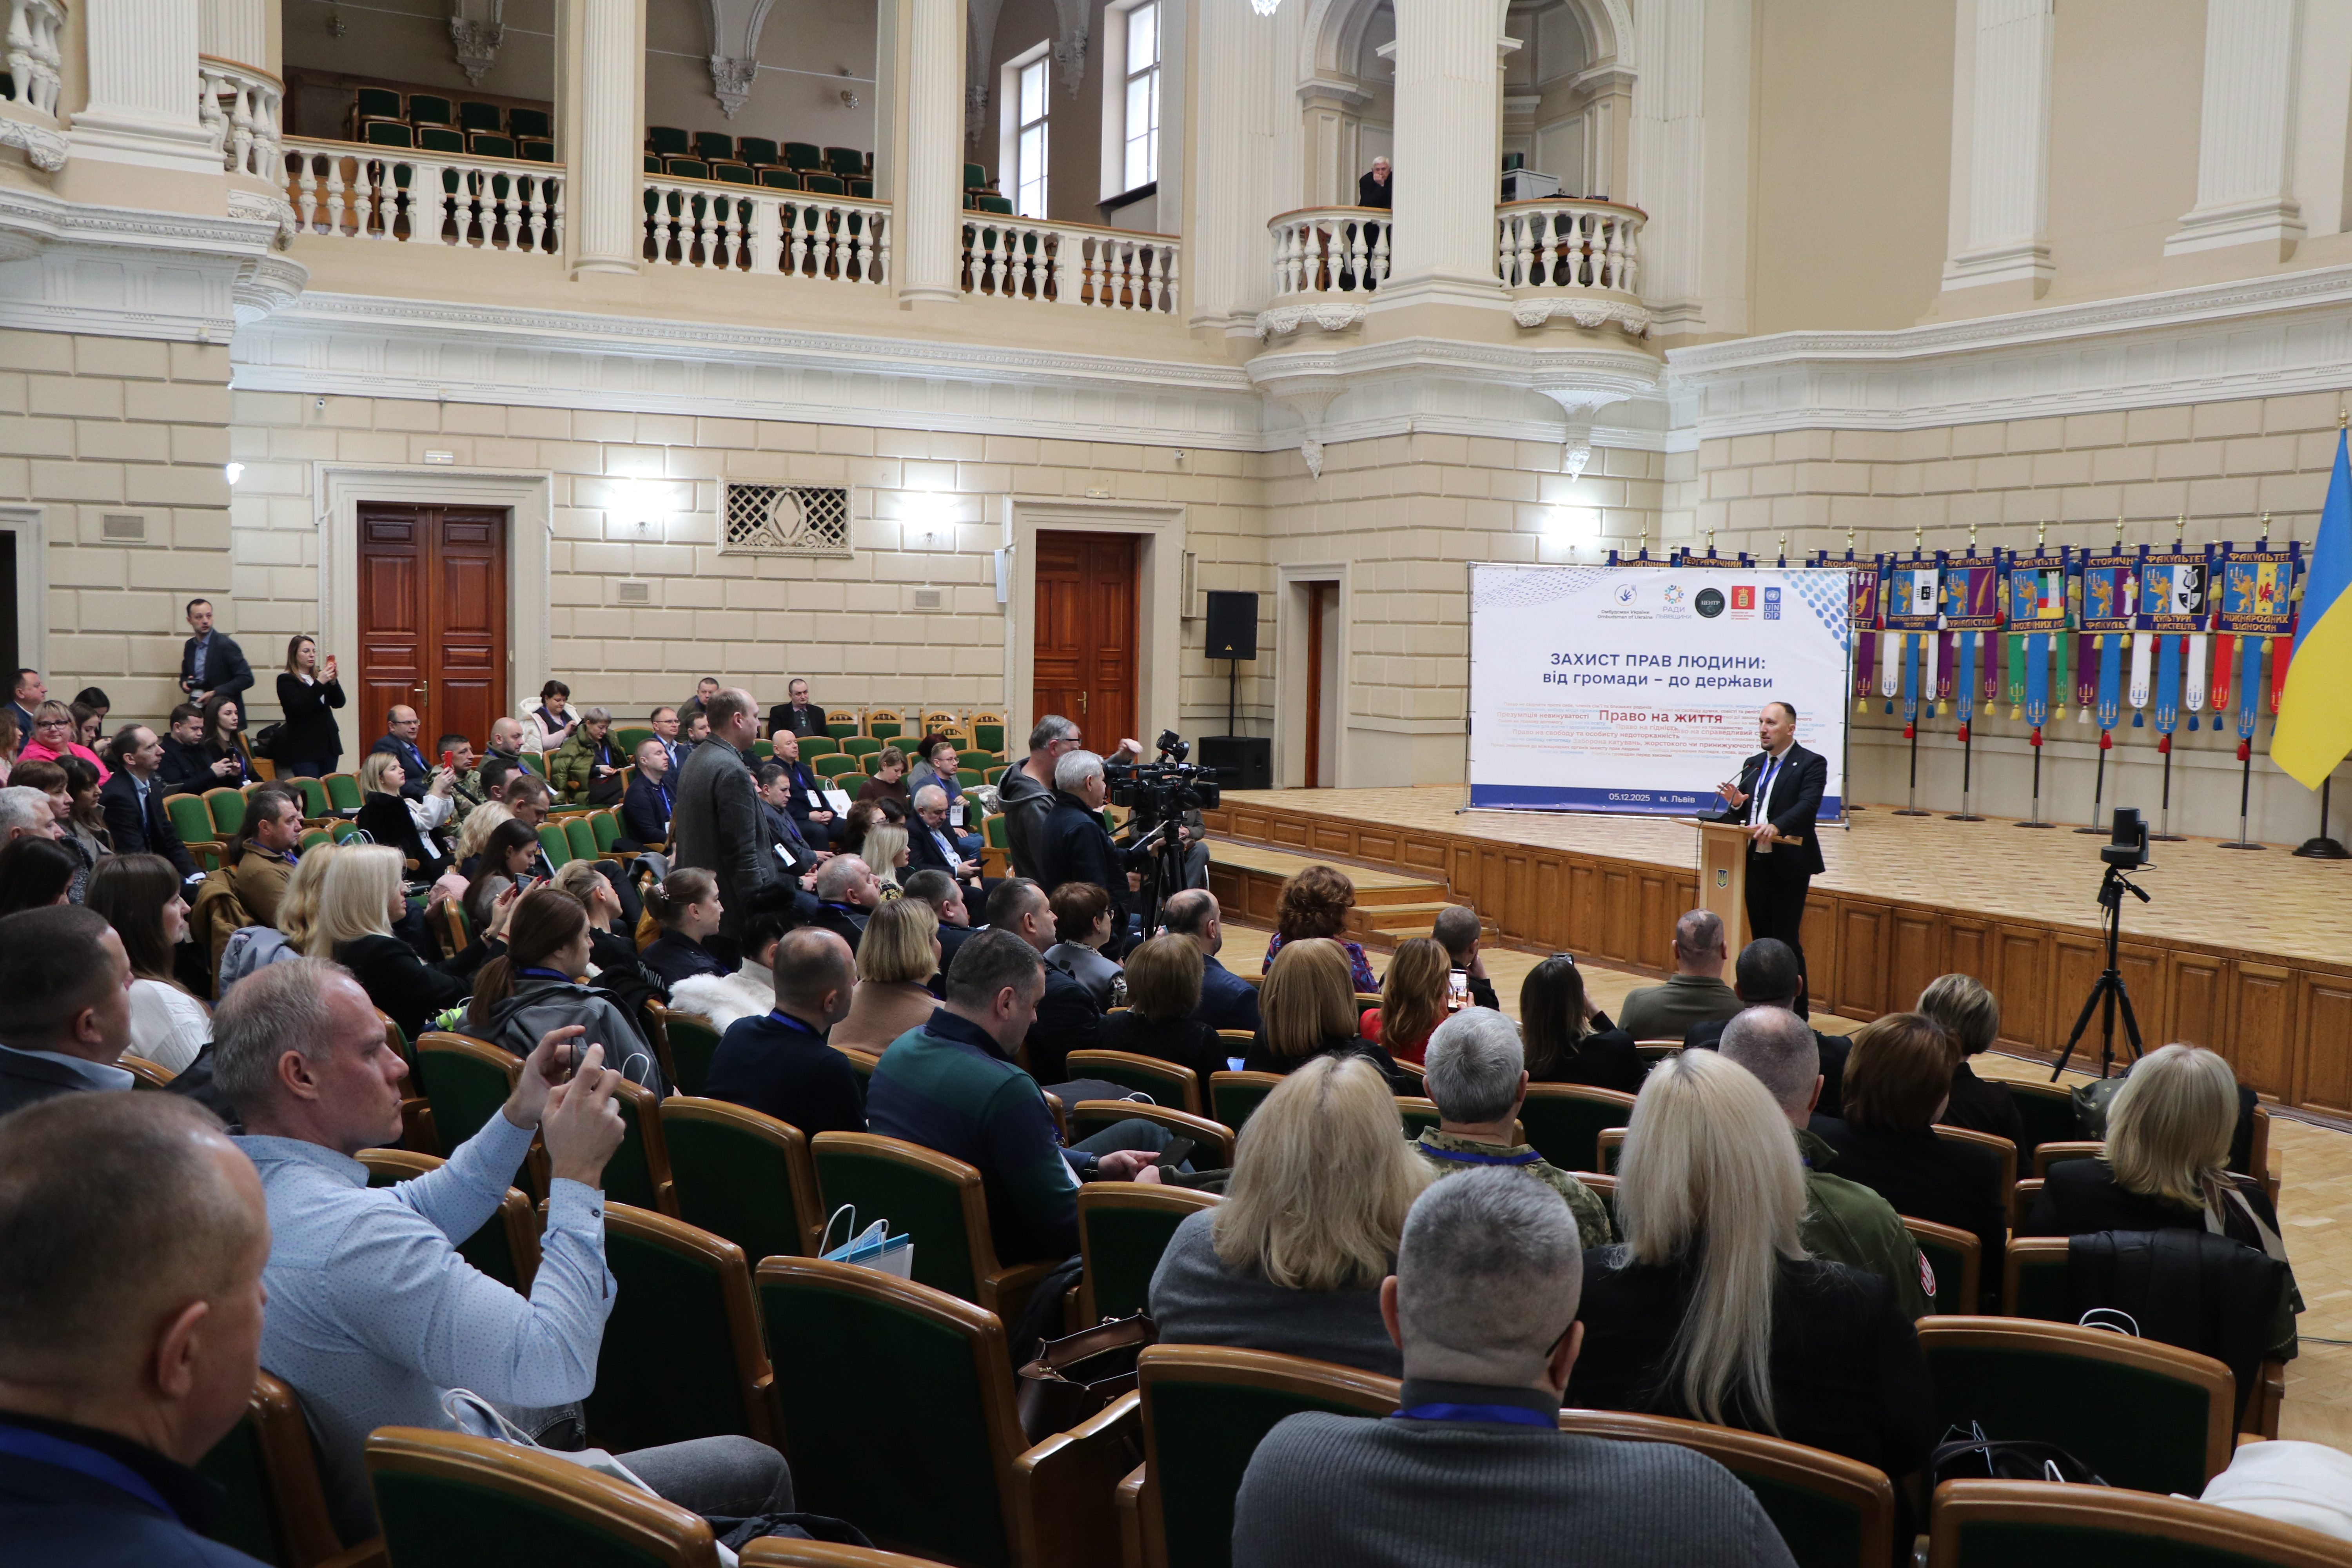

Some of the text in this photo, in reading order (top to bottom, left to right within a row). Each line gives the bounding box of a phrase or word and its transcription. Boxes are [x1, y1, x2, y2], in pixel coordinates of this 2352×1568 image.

[1682, 557, 1742, 567] ГЕОГРАФІЧНИЙ
[1946, 557, 1994, 567] ФАКУЛЬТЕТ
[2088, 557, 2134, 566] ІСТОРИЧН
[2145, 555, 2207, 563] ФАКУЛЬТЕТ
[2229, 553, 2290, 561] ФАКУЛЬТЕТ
[1823, 560, 1878, 570] ЕКОНОМІЧНИЙ
[2223, 614, 2288, 624] МІЖНАРОДНИХ
[2232, 622, 2277, 632] ВІДНОСИН
[1551, 653, 1766, 670] ЗАХИСТ ПРАВ ЛЮДИНИ:
[1543, 670, 1568, 684] від
[1573, 673, 1648, 687] громади
[1668, 677, 1690, 688] до
[1695, 675, 1773, 690] держави
[1599, 710, 1646, 723] Право
[1651, 713, 1669, 722] на
[1674, 713, 1722, 724] життя
[1608, 793, 1651, 802] 05.12.2025
